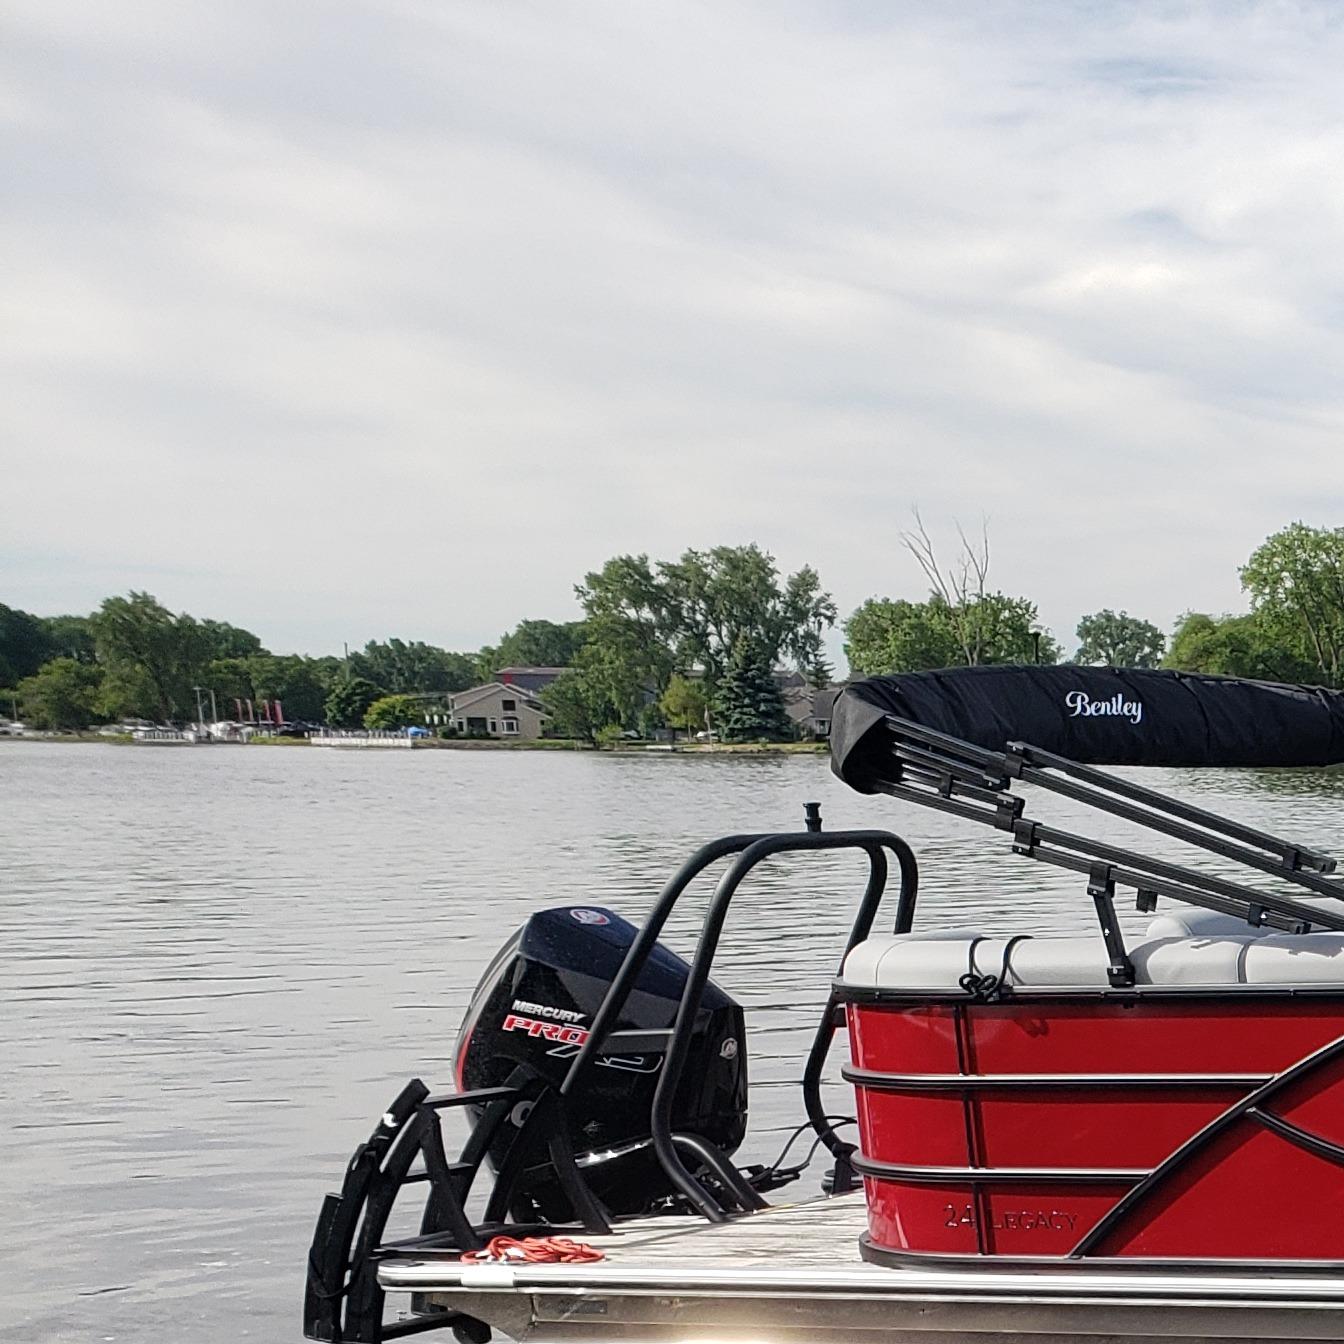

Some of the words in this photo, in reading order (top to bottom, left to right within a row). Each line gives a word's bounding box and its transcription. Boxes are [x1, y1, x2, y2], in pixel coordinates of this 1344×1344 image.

[1065, 690, 1142, 724] Bentley
[511, 999, 587, 1023] MERCURY
[502, 1014, 592, 1047] PRO
[943, 1204, 975, 1228] 24
[989, 1211, 1078, 1231] LEGACY
